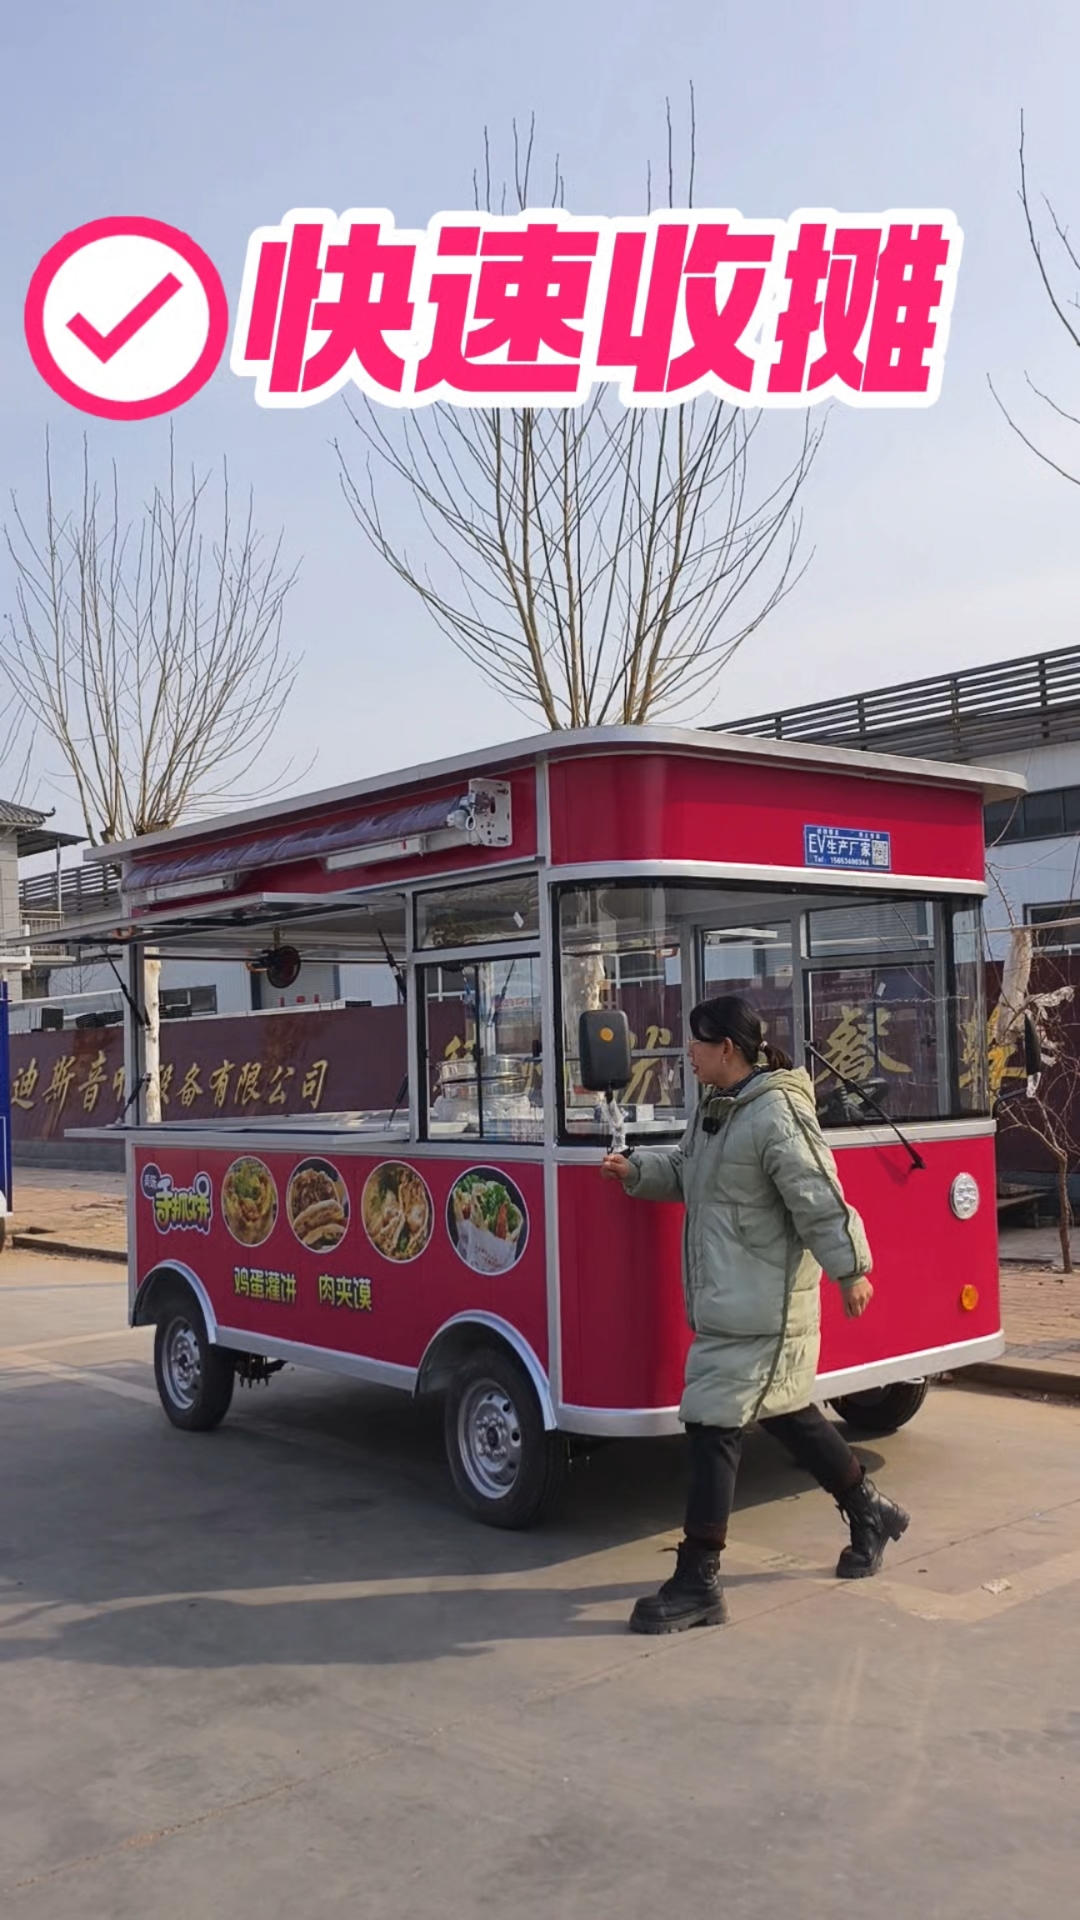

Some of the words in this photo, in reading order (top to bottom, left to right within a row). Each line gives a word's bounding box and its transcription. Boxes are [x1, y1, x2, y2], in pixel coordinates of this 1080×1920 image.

[808, 833, 871, 857] EV生产厂家
[234, 1266, 297, 1304] 鸡蛋灌饼
[318, 1273, 372, 1311] 肉夹馍
